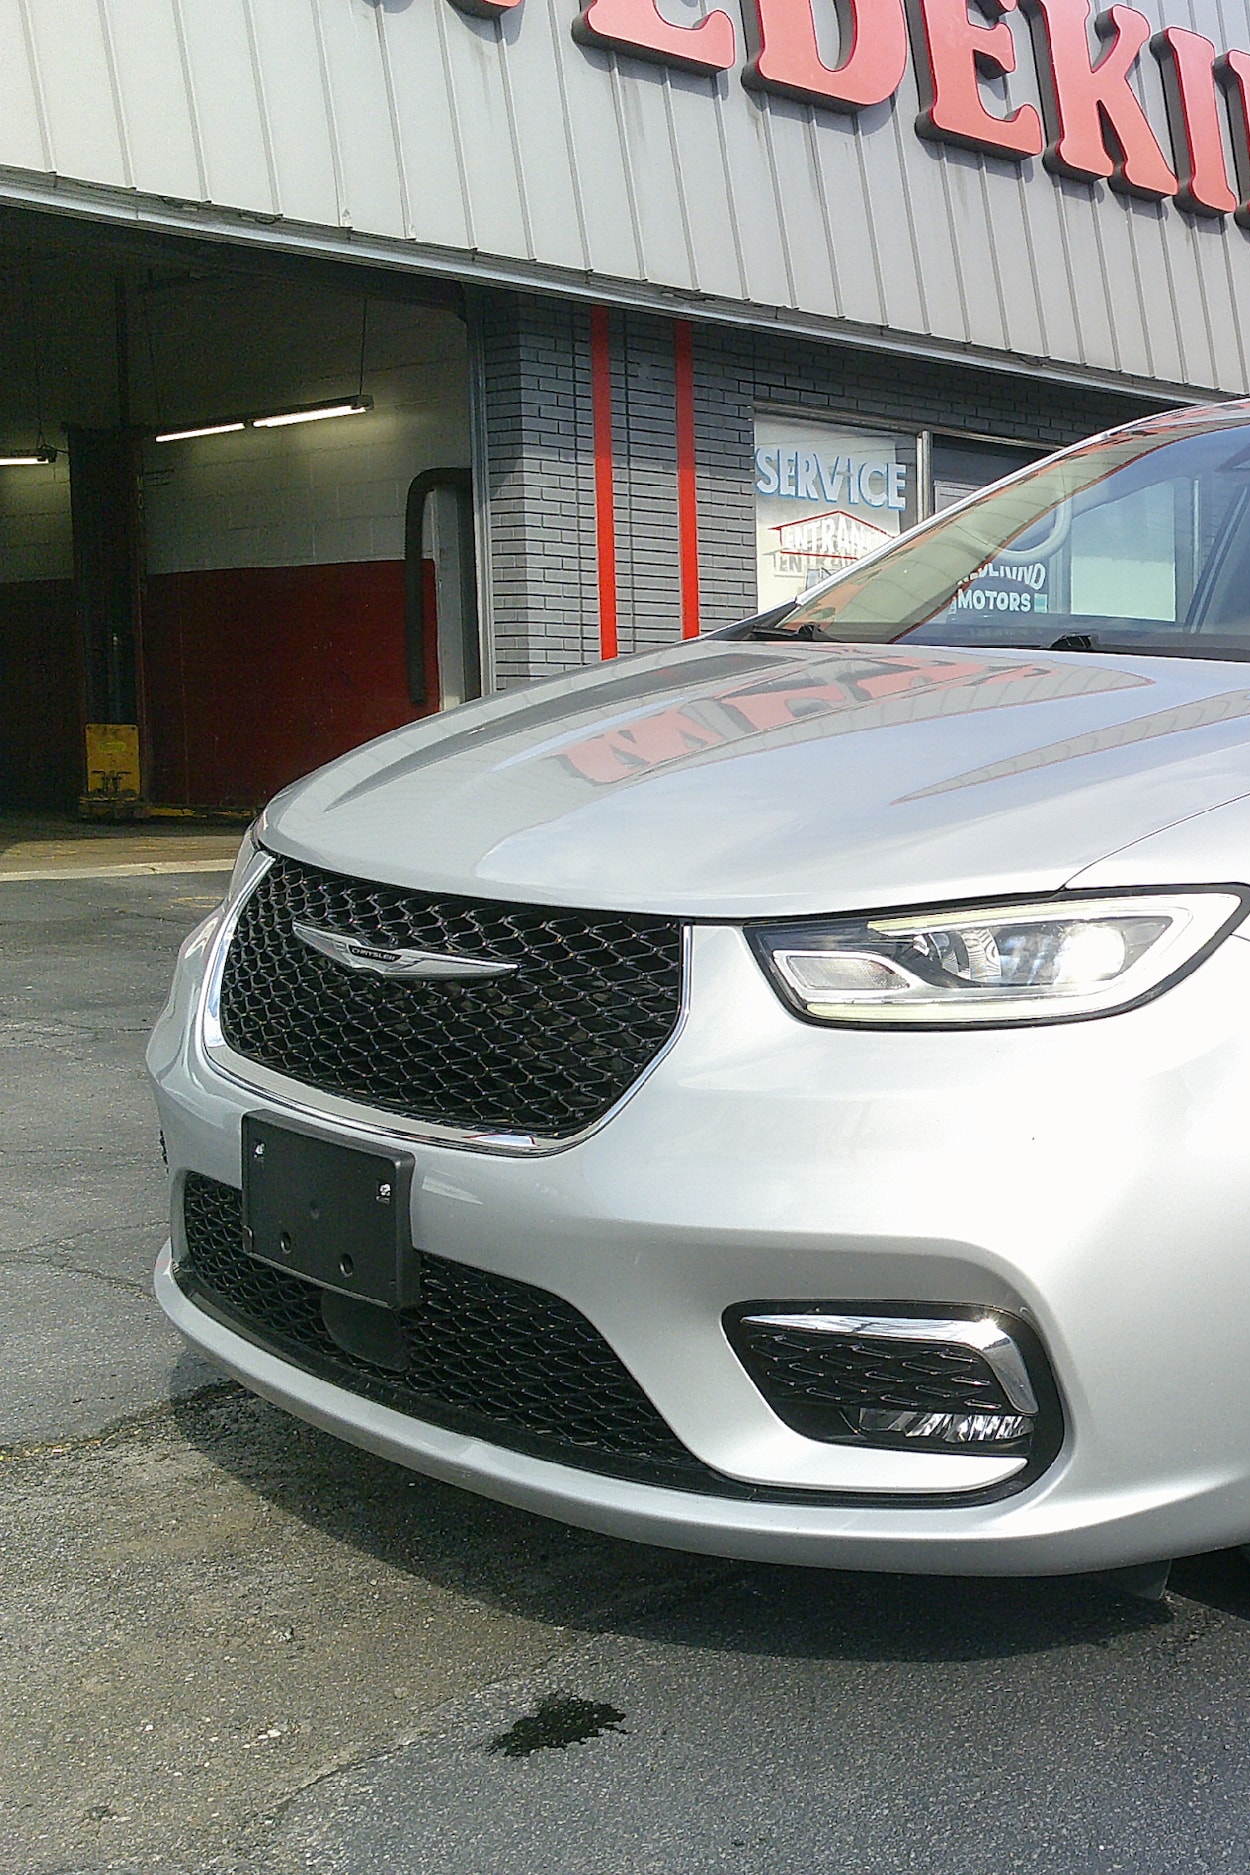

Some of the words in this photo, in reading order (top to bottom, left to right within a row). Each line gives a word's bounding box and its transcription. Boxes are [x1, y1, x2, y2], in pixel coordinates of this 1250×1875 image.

[755, 447, 907, 511] SERVICE
[782, 515, 888, 556] ENTRANC
[957, 588, 1031, 613] MOTORS
[351, 947, 397, 961] CHRYSLER
